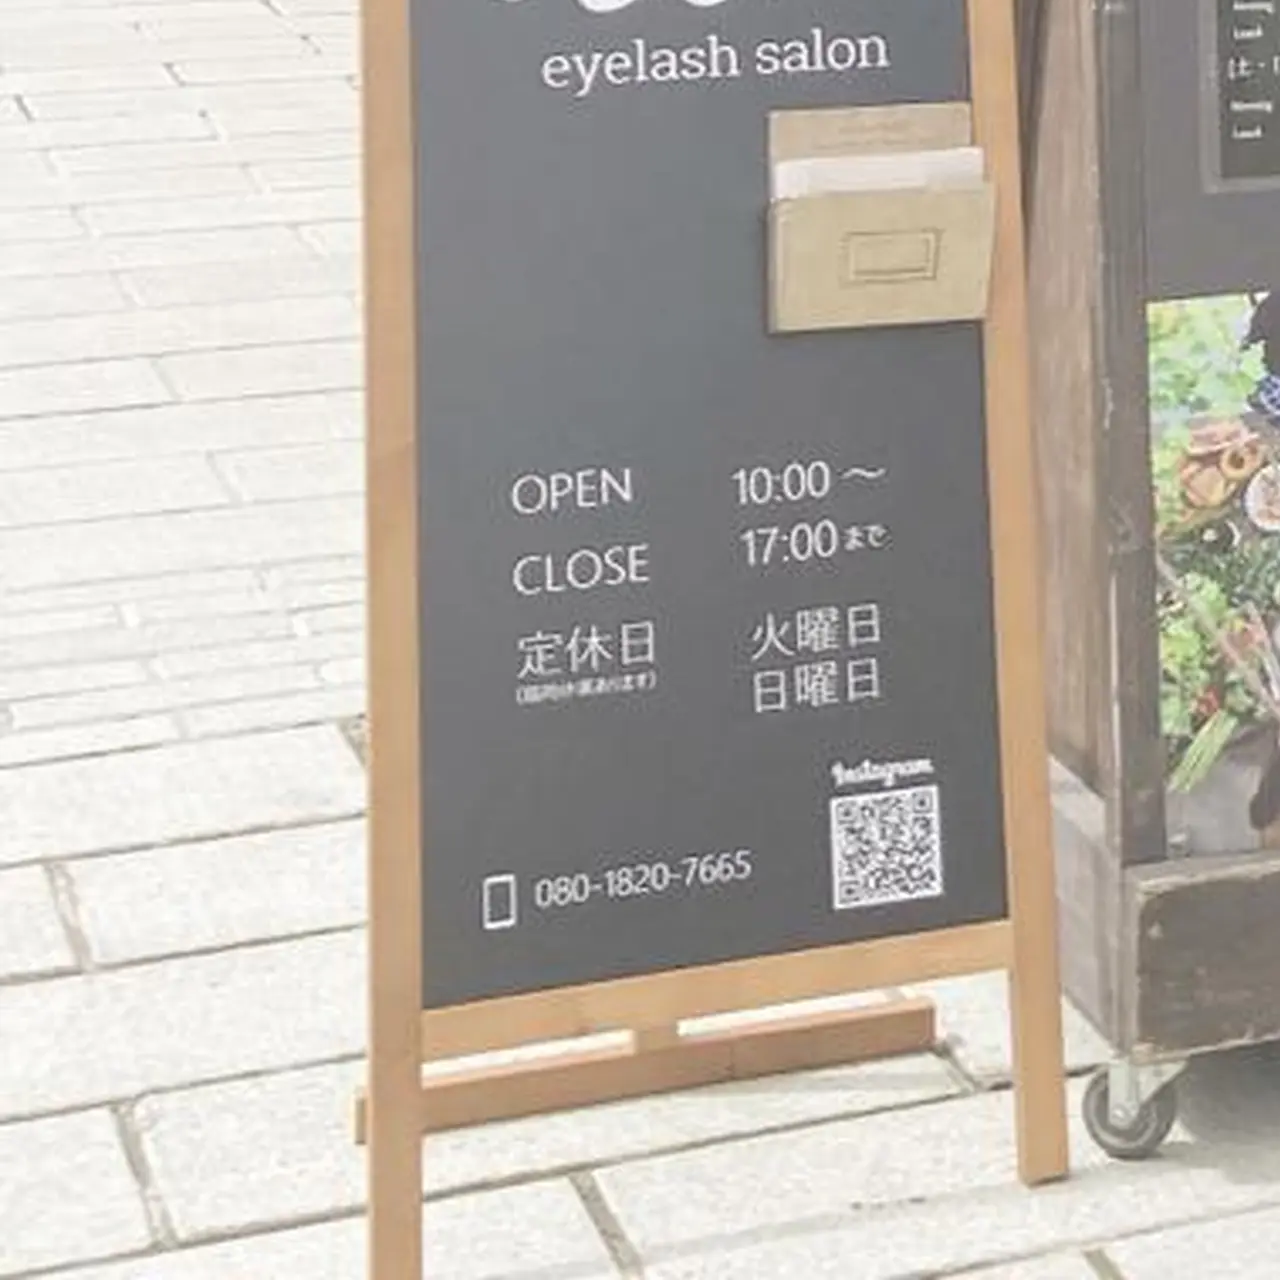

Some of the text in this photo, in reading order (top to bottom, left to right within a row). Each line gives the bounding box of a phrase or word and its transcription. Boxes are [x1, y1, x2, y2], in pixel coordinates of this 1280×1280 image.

[541, 27, 890, 98] eyelash salon
[511, 467, 633, 515] OPEN
[512, 544, 651, 596] CLOSE
[516, 603, 881, 680] 定休日 火曜日
[752, 657, 881, 714] 日曜日
[534, 850, 752, 909] 080-1820-7665
